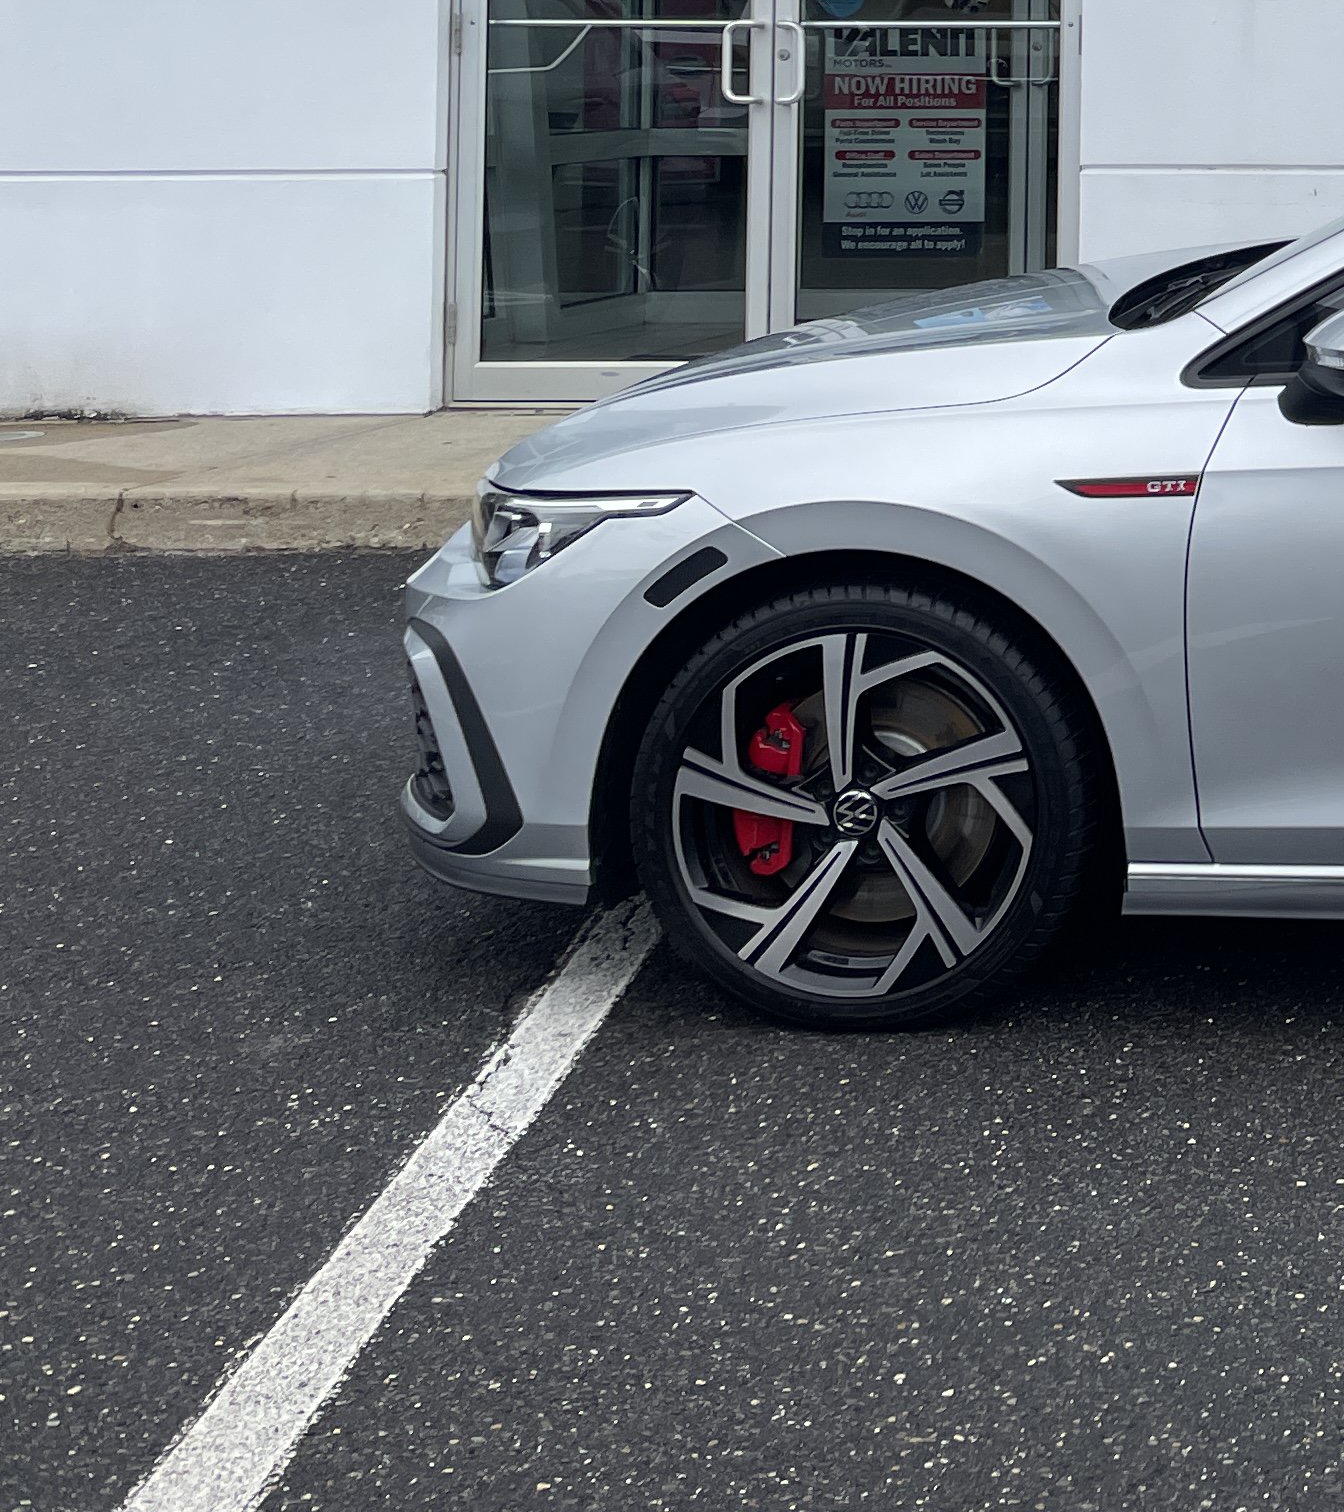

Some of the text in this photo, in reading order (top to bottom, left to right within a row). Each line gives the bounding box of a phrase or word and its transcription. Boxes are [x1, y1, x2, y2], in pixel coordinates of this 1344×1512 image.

[833, 59, 885, 68] MOTORS
[834, 76, 977, 95] NOW HIRING
[854, 96, 957, 107] For All Positions
[877, 226, 890, 235] for
[1146, 480, 1187, 493] GTI
